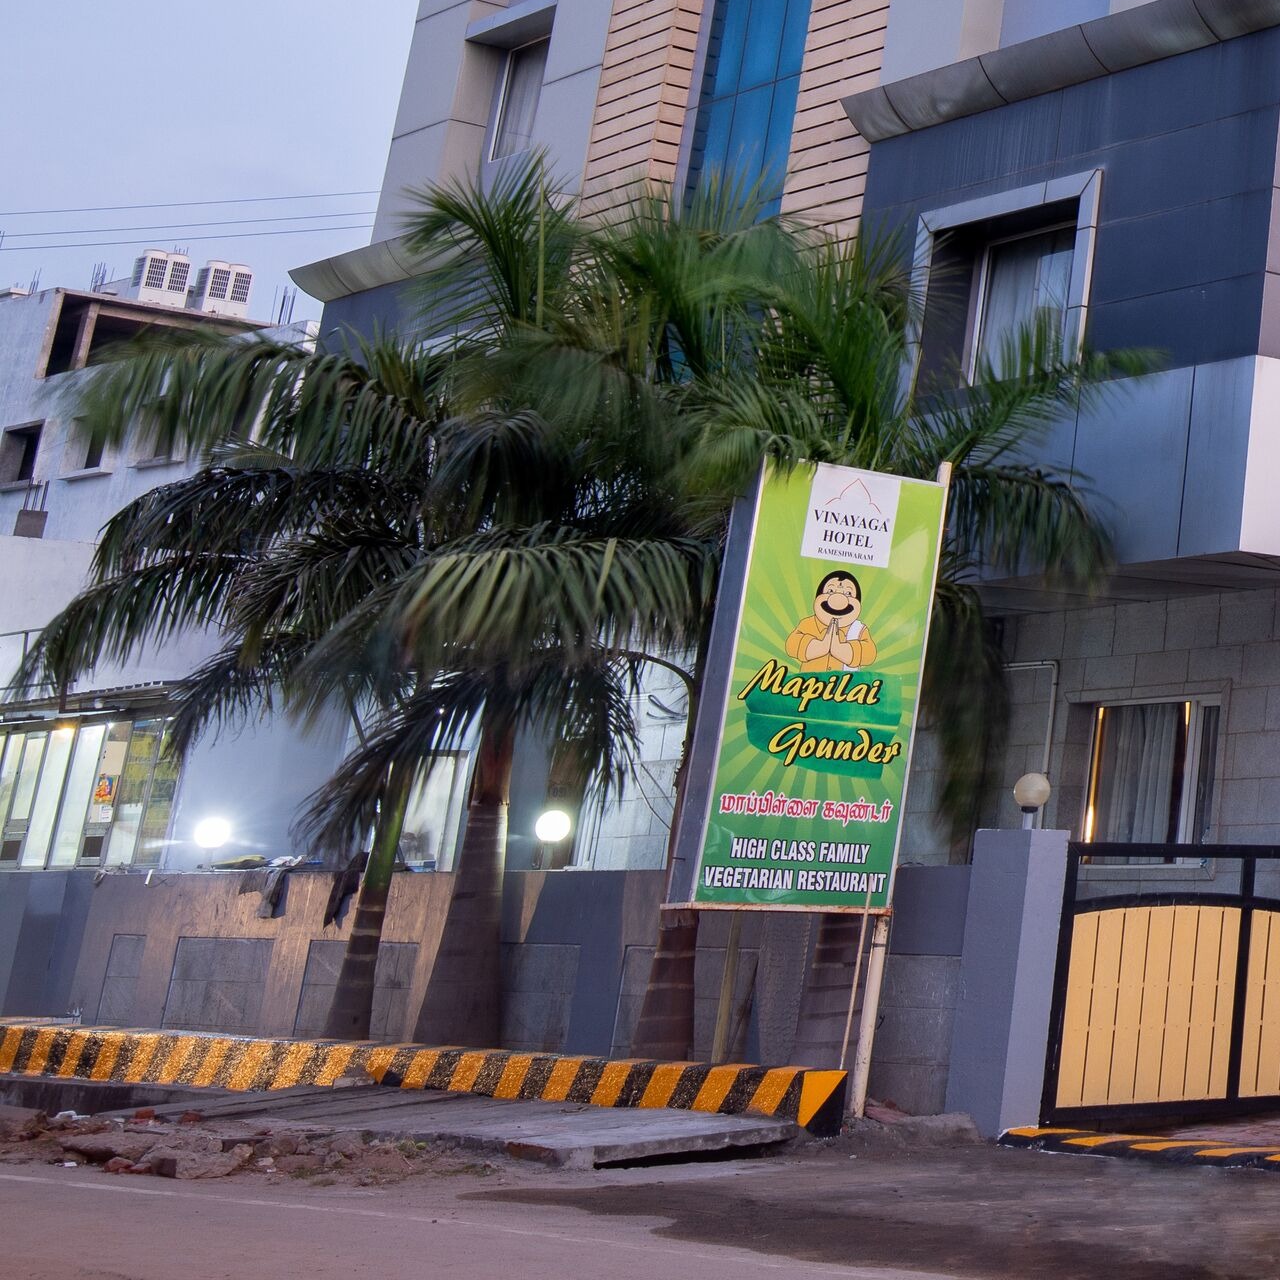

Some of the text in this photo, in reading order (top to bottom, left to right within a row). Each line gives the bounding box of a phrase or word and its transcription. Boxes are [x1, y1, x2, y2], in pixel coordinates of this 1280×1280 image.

[814, 509, 889, 533] VINAYAGA
[823, 529, 874, 549] HOTEL
[817, 546, 875, 561] RAMESHWARAM
[737, 659, 883, 712] Mapilai
[768, 722, 902, 766] Gounder
[720, 790, 893, 826] மாப்பிள்ளை கவுண்டர்
[730, 837, 870, 864] HIGH CLASS FAMILY
[704, 866, 887, 893] VEGETARIAN RESTAURANT
